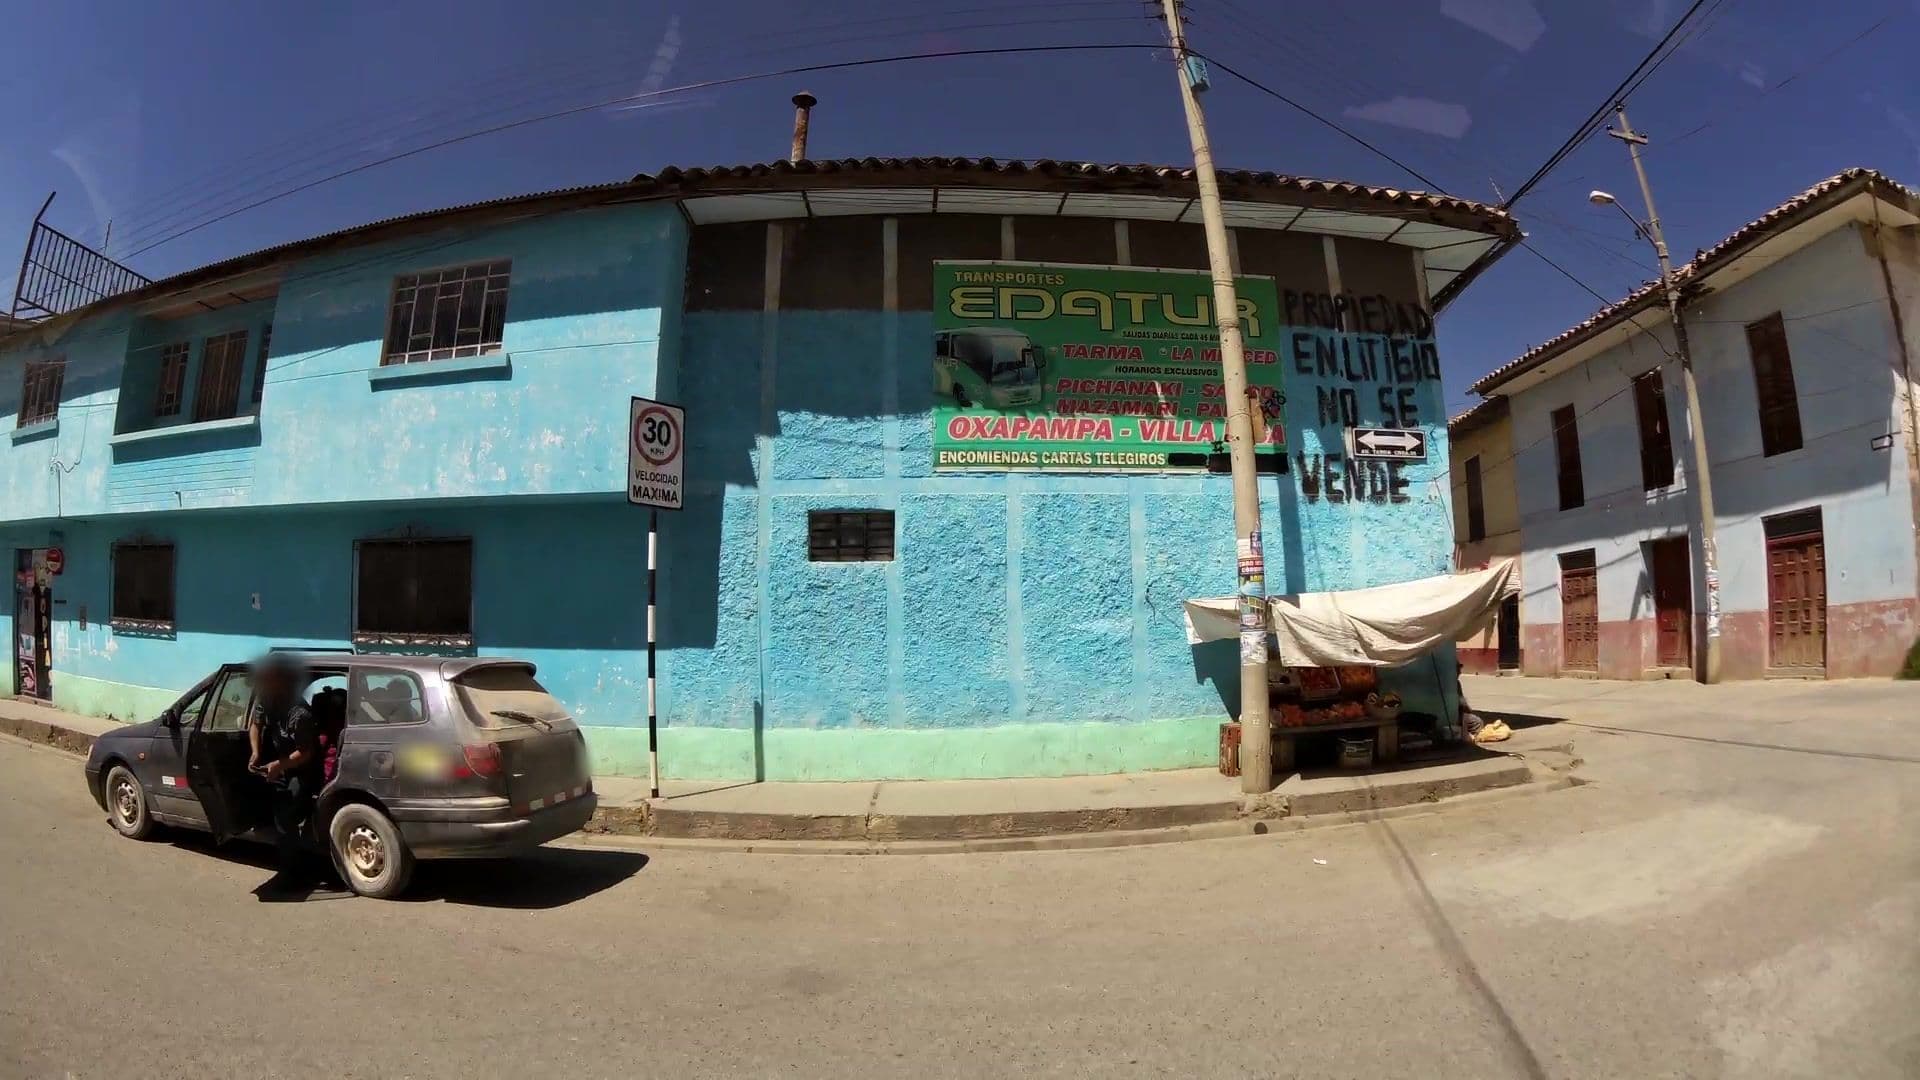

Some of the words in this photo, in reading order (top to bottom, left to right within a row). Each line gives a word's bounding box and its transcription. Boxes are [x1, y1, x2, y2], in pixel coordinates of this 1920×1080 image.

[955, 271, 1065, 285] TRANSPORTES
[1122, 330, 1151, 338] SALIDAS
[1181, 333, 1199, 341] CADA
[1062, 344, 1144, 361] TARMA
[1171, 346, 1195, 361] LA
[1200, 347, 1278, 364] MCED
[1115, 365, 1162, 375] HORARIOS
[1164, 367, 1218, 376] EXCLUSIVOS
[1056, 378, 1183, 397] PICHANAKI
[1056, 399, 1179, 417] MAZAMARI
[1317, 385, 1358, 428] NO
[1377, 386, 1420, 428] SE
[642, 417, 671, 447] 30
[948, 416, 1114, 441] OXAPAMPA
[1138, 419, 1215, 442] VILLA
[939, 450, 1038, 464] ENCOMIENDAS
[1041, 451, 1092, 465] CARTAS
[1095, 453, 1166, 465] TELEGIROS
[635, 469, 679, 485] VELOCIDAD
[1297, 450, 1412, 505] VENDE
[633, 485, 679, 503] MAXIMA
